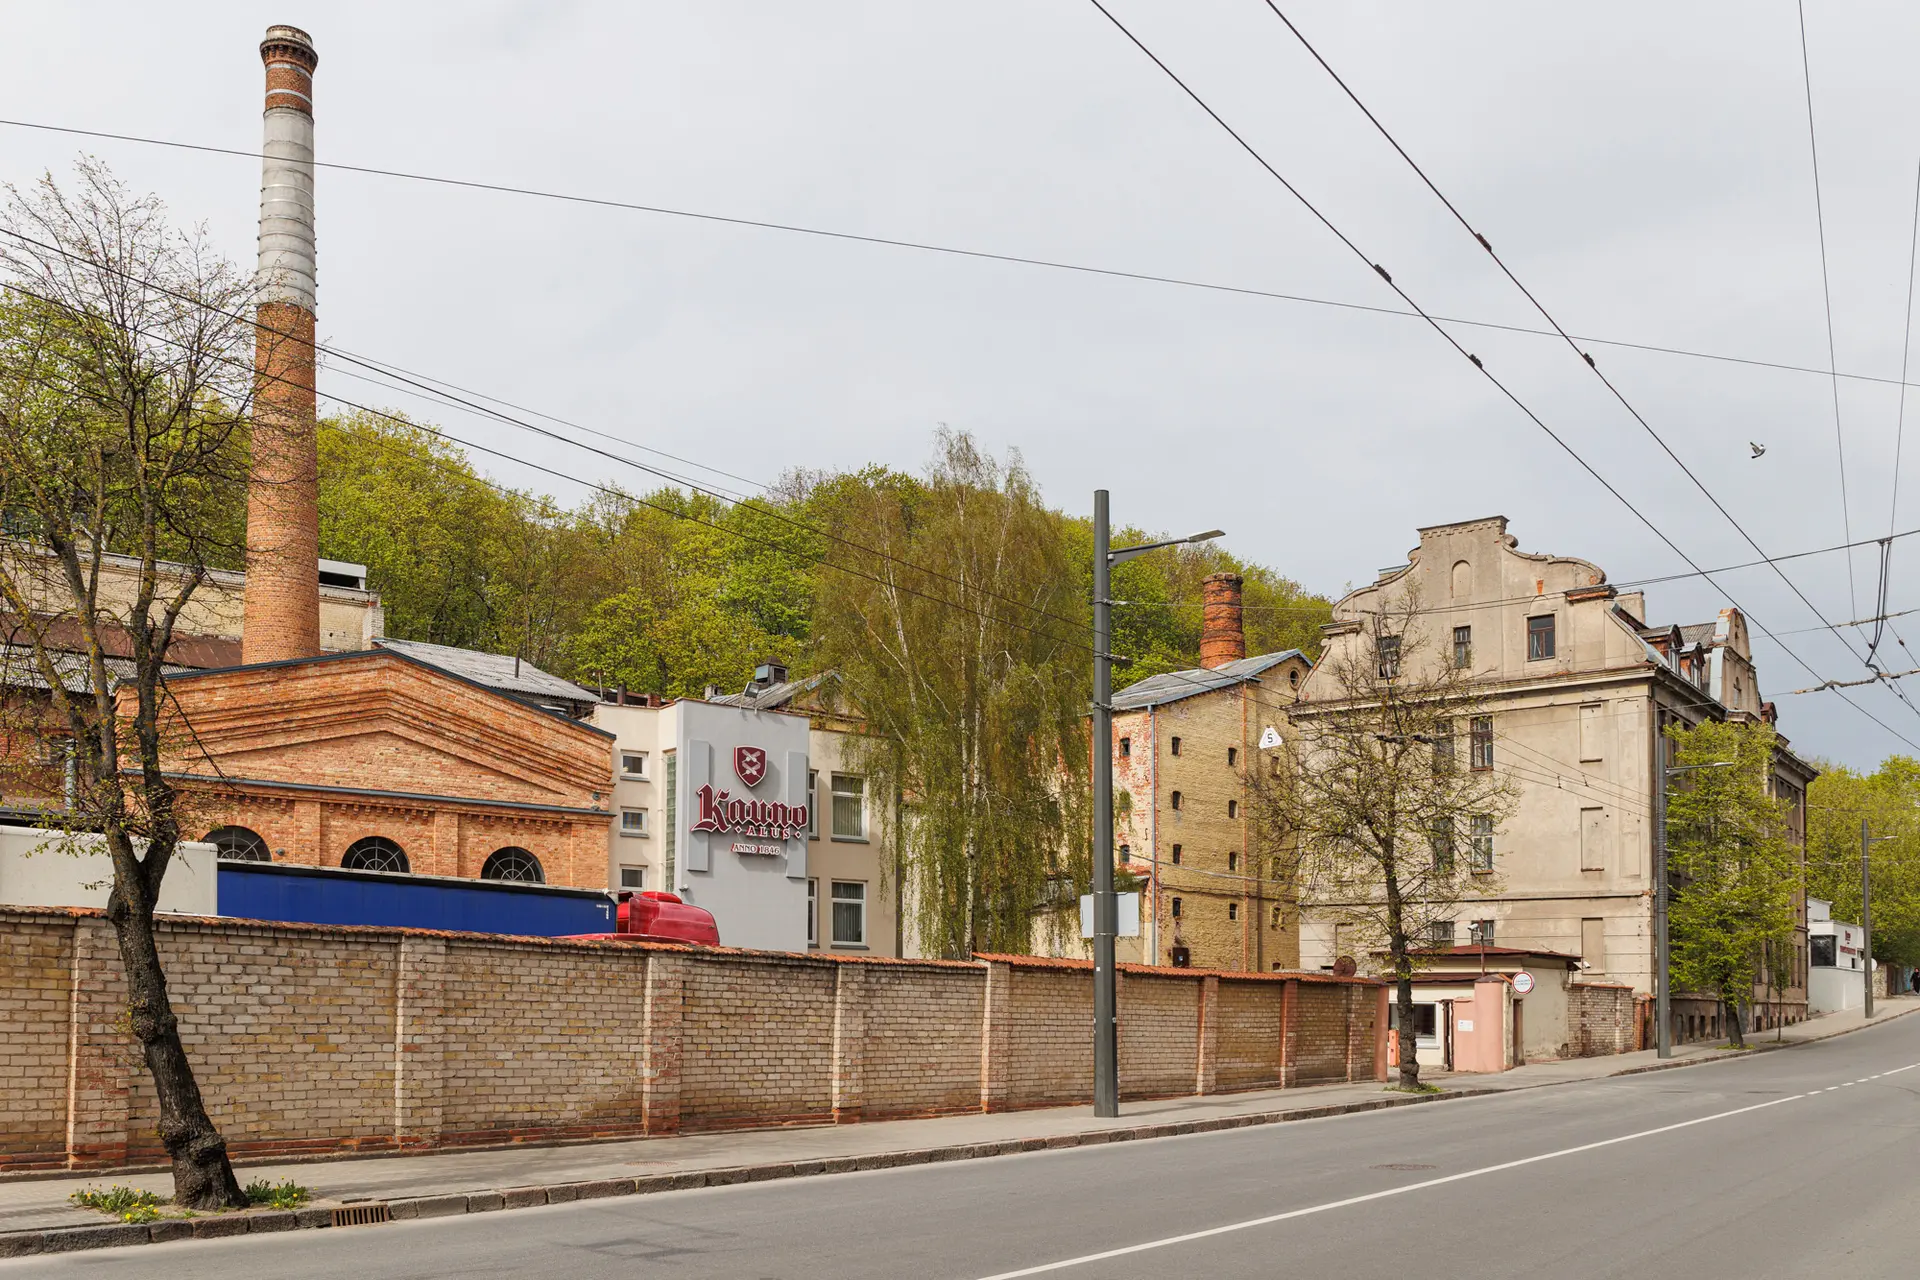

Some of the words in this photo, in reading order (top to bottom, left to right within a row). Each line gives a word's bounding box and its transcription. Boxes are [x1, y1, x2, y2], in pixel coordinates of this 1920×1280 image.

[690, 783, 808, 834] Kauno
[746, 826, 790, 840] ALUS
[732, 843, 757, 854] ANNO
[758, 845, 780, 856] 1846
